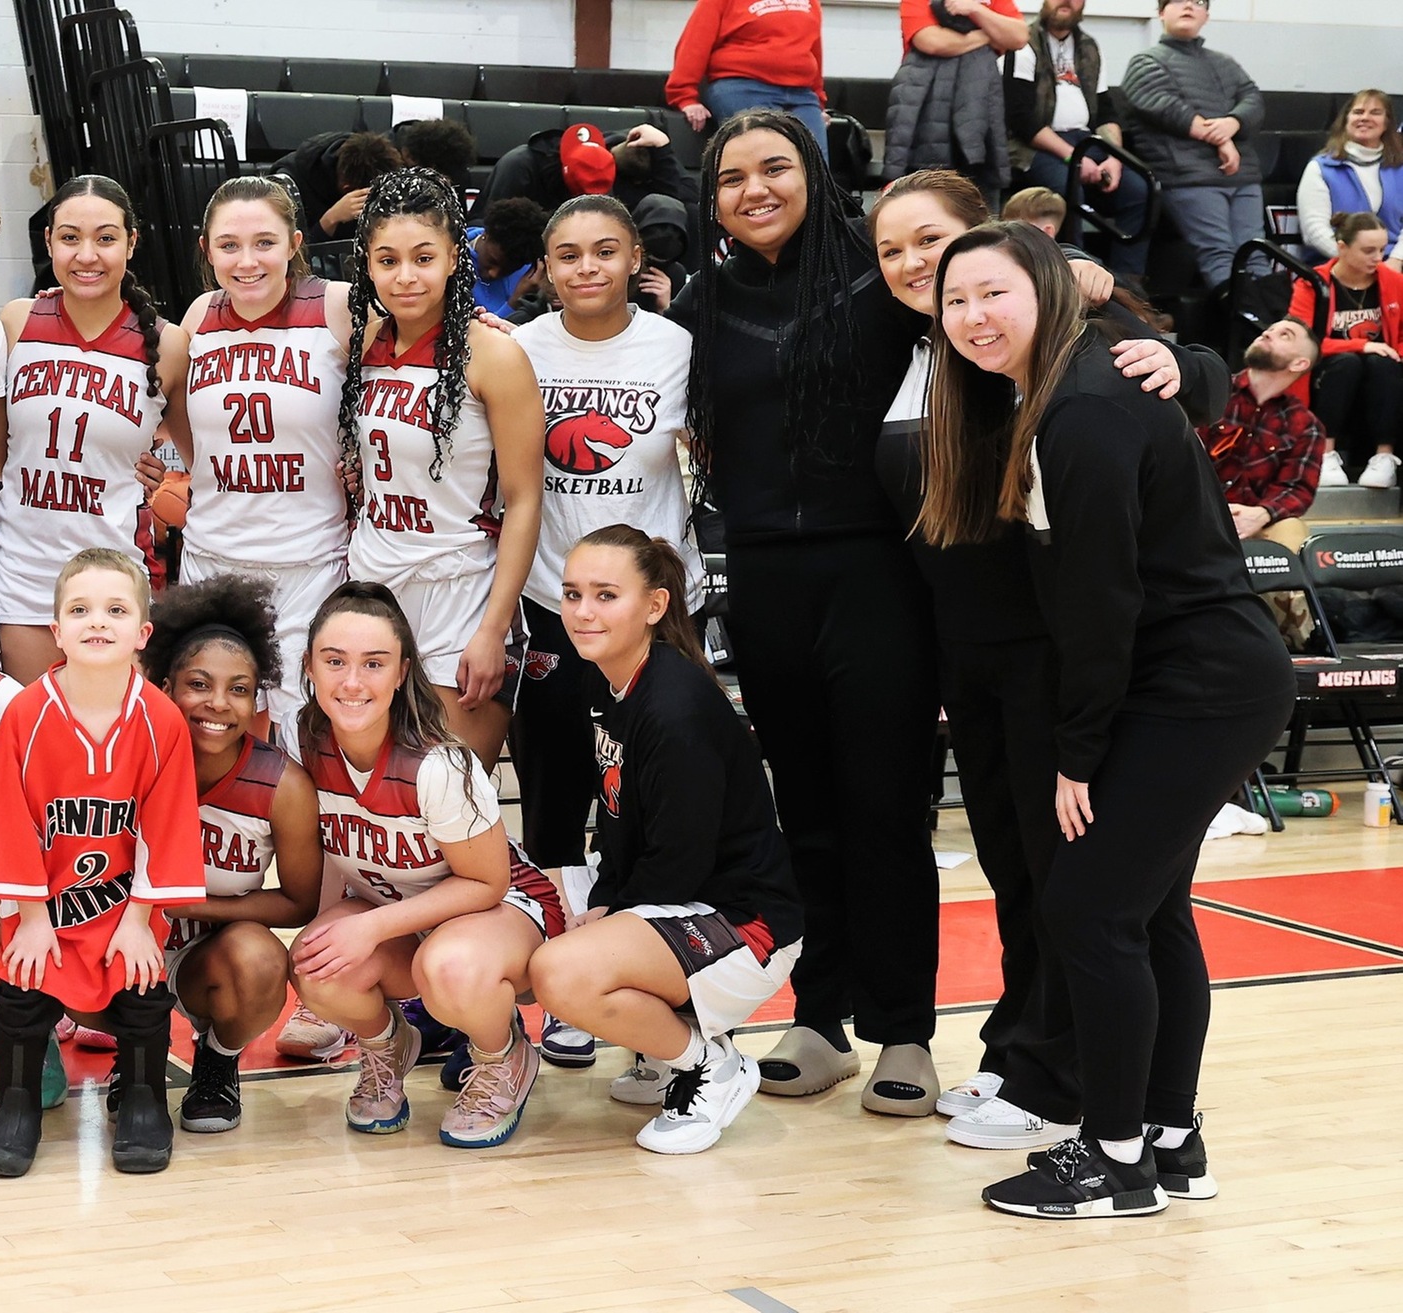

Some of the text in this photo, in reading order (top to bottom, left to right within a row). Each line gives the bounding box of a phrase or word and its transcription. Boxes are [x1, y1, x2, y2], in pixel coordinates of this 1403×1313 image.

[189, 343, 321, 394] CENTRAL
[578, 378, 622, 386] COMMUNITY
[11, 359, 144, 428] CENTRAL
[540, 386, 661, 434] USTANGS
[45, 407, 90, 462] 11
[223, 393, 277, 444] 20
[210, 453, 304, 493] MAINE
[369, 429, 393, 481] 3
[20, 467, 106, 516] MAINE
[544, 476, 644, 495] SKETBALL
[367, 494, 435, 534] AINE
[1333, 549, 1403, 562] Central Main
[1318, 669, 1396, 688] MUSTANGS
[319, 813, 445, 870] ENTRAL
[62, 850, 110, 892] 2
